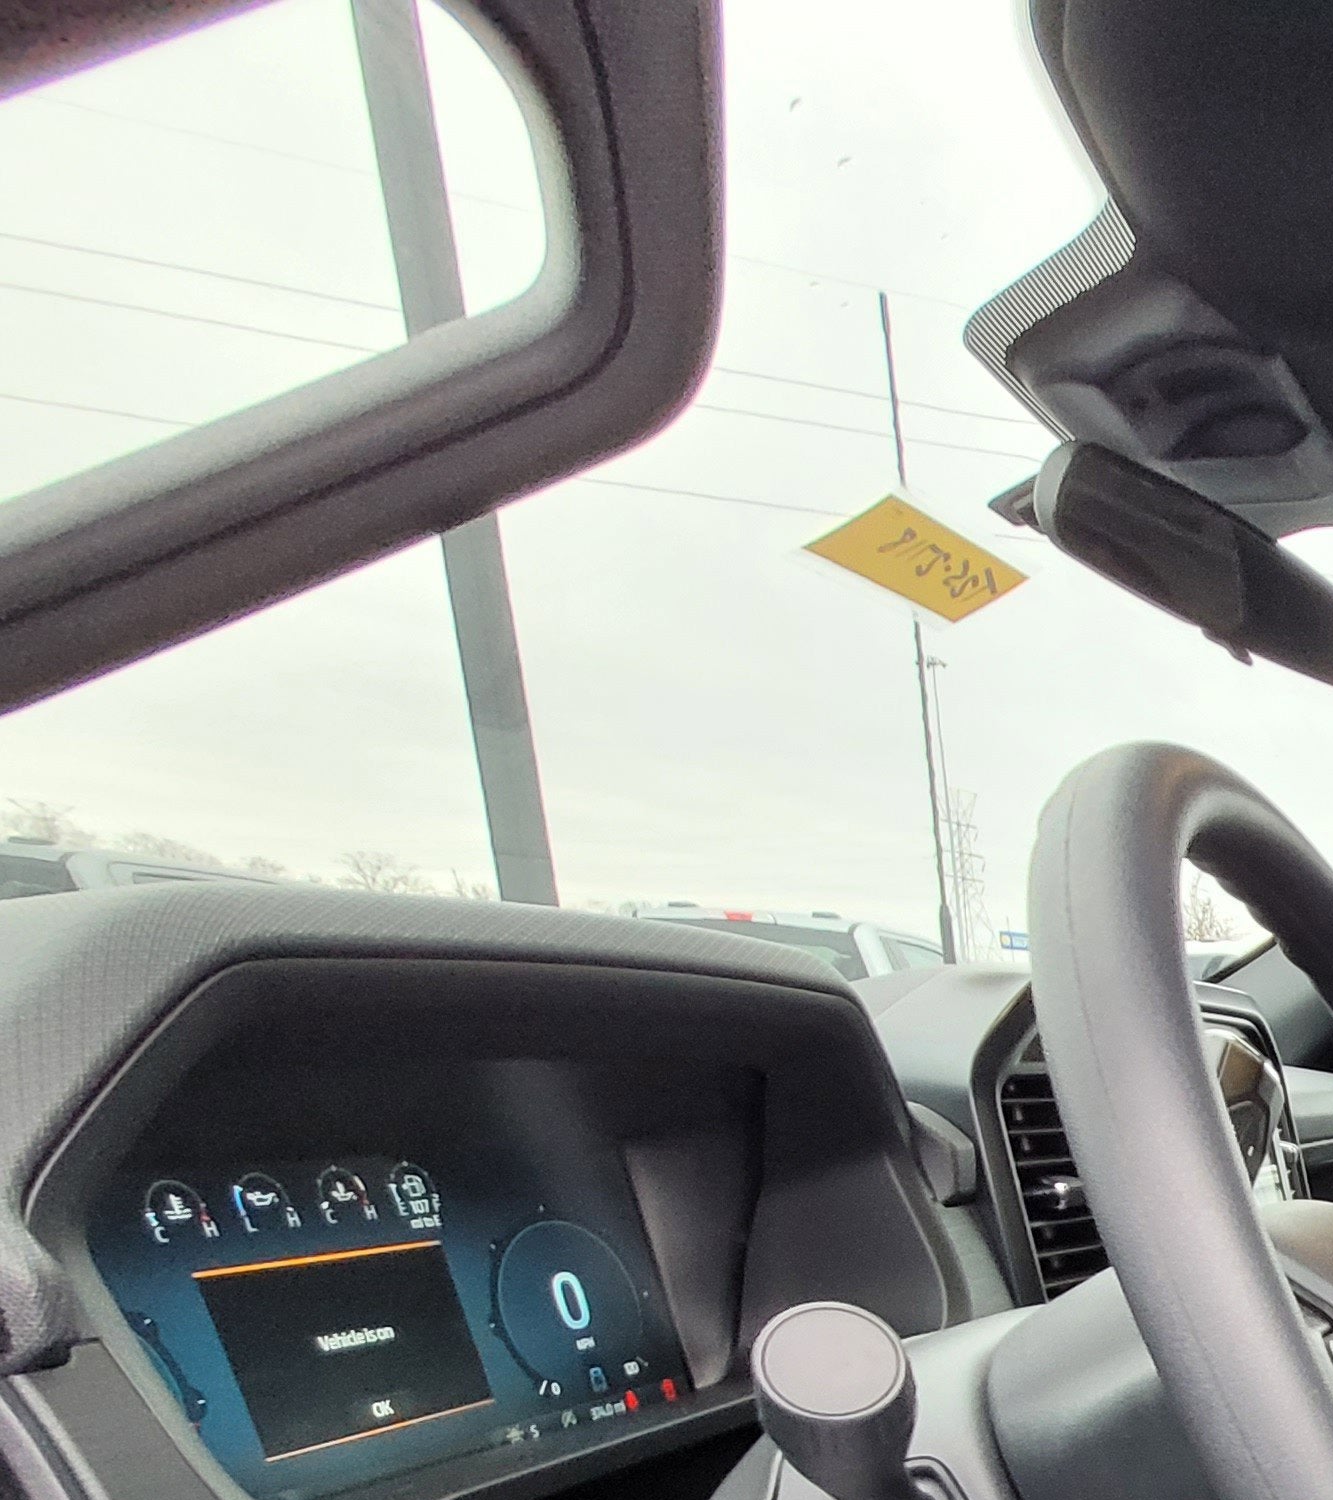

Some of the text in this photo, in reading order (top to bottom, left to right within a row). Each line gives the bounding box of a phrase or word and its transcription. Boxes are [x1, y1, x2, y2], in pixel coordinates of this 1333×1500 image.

[363, 1205, 378, 1220] H
[154, 1227, 170, 1243] C
[202, 1221, 220, 1238] H
[553, 1271, 590, 1330] 0
[317, 1330, 366, 1352] Vehicle
[376, 1327, 395, 1341] on
[372, 1400, 395, 1418] OK
